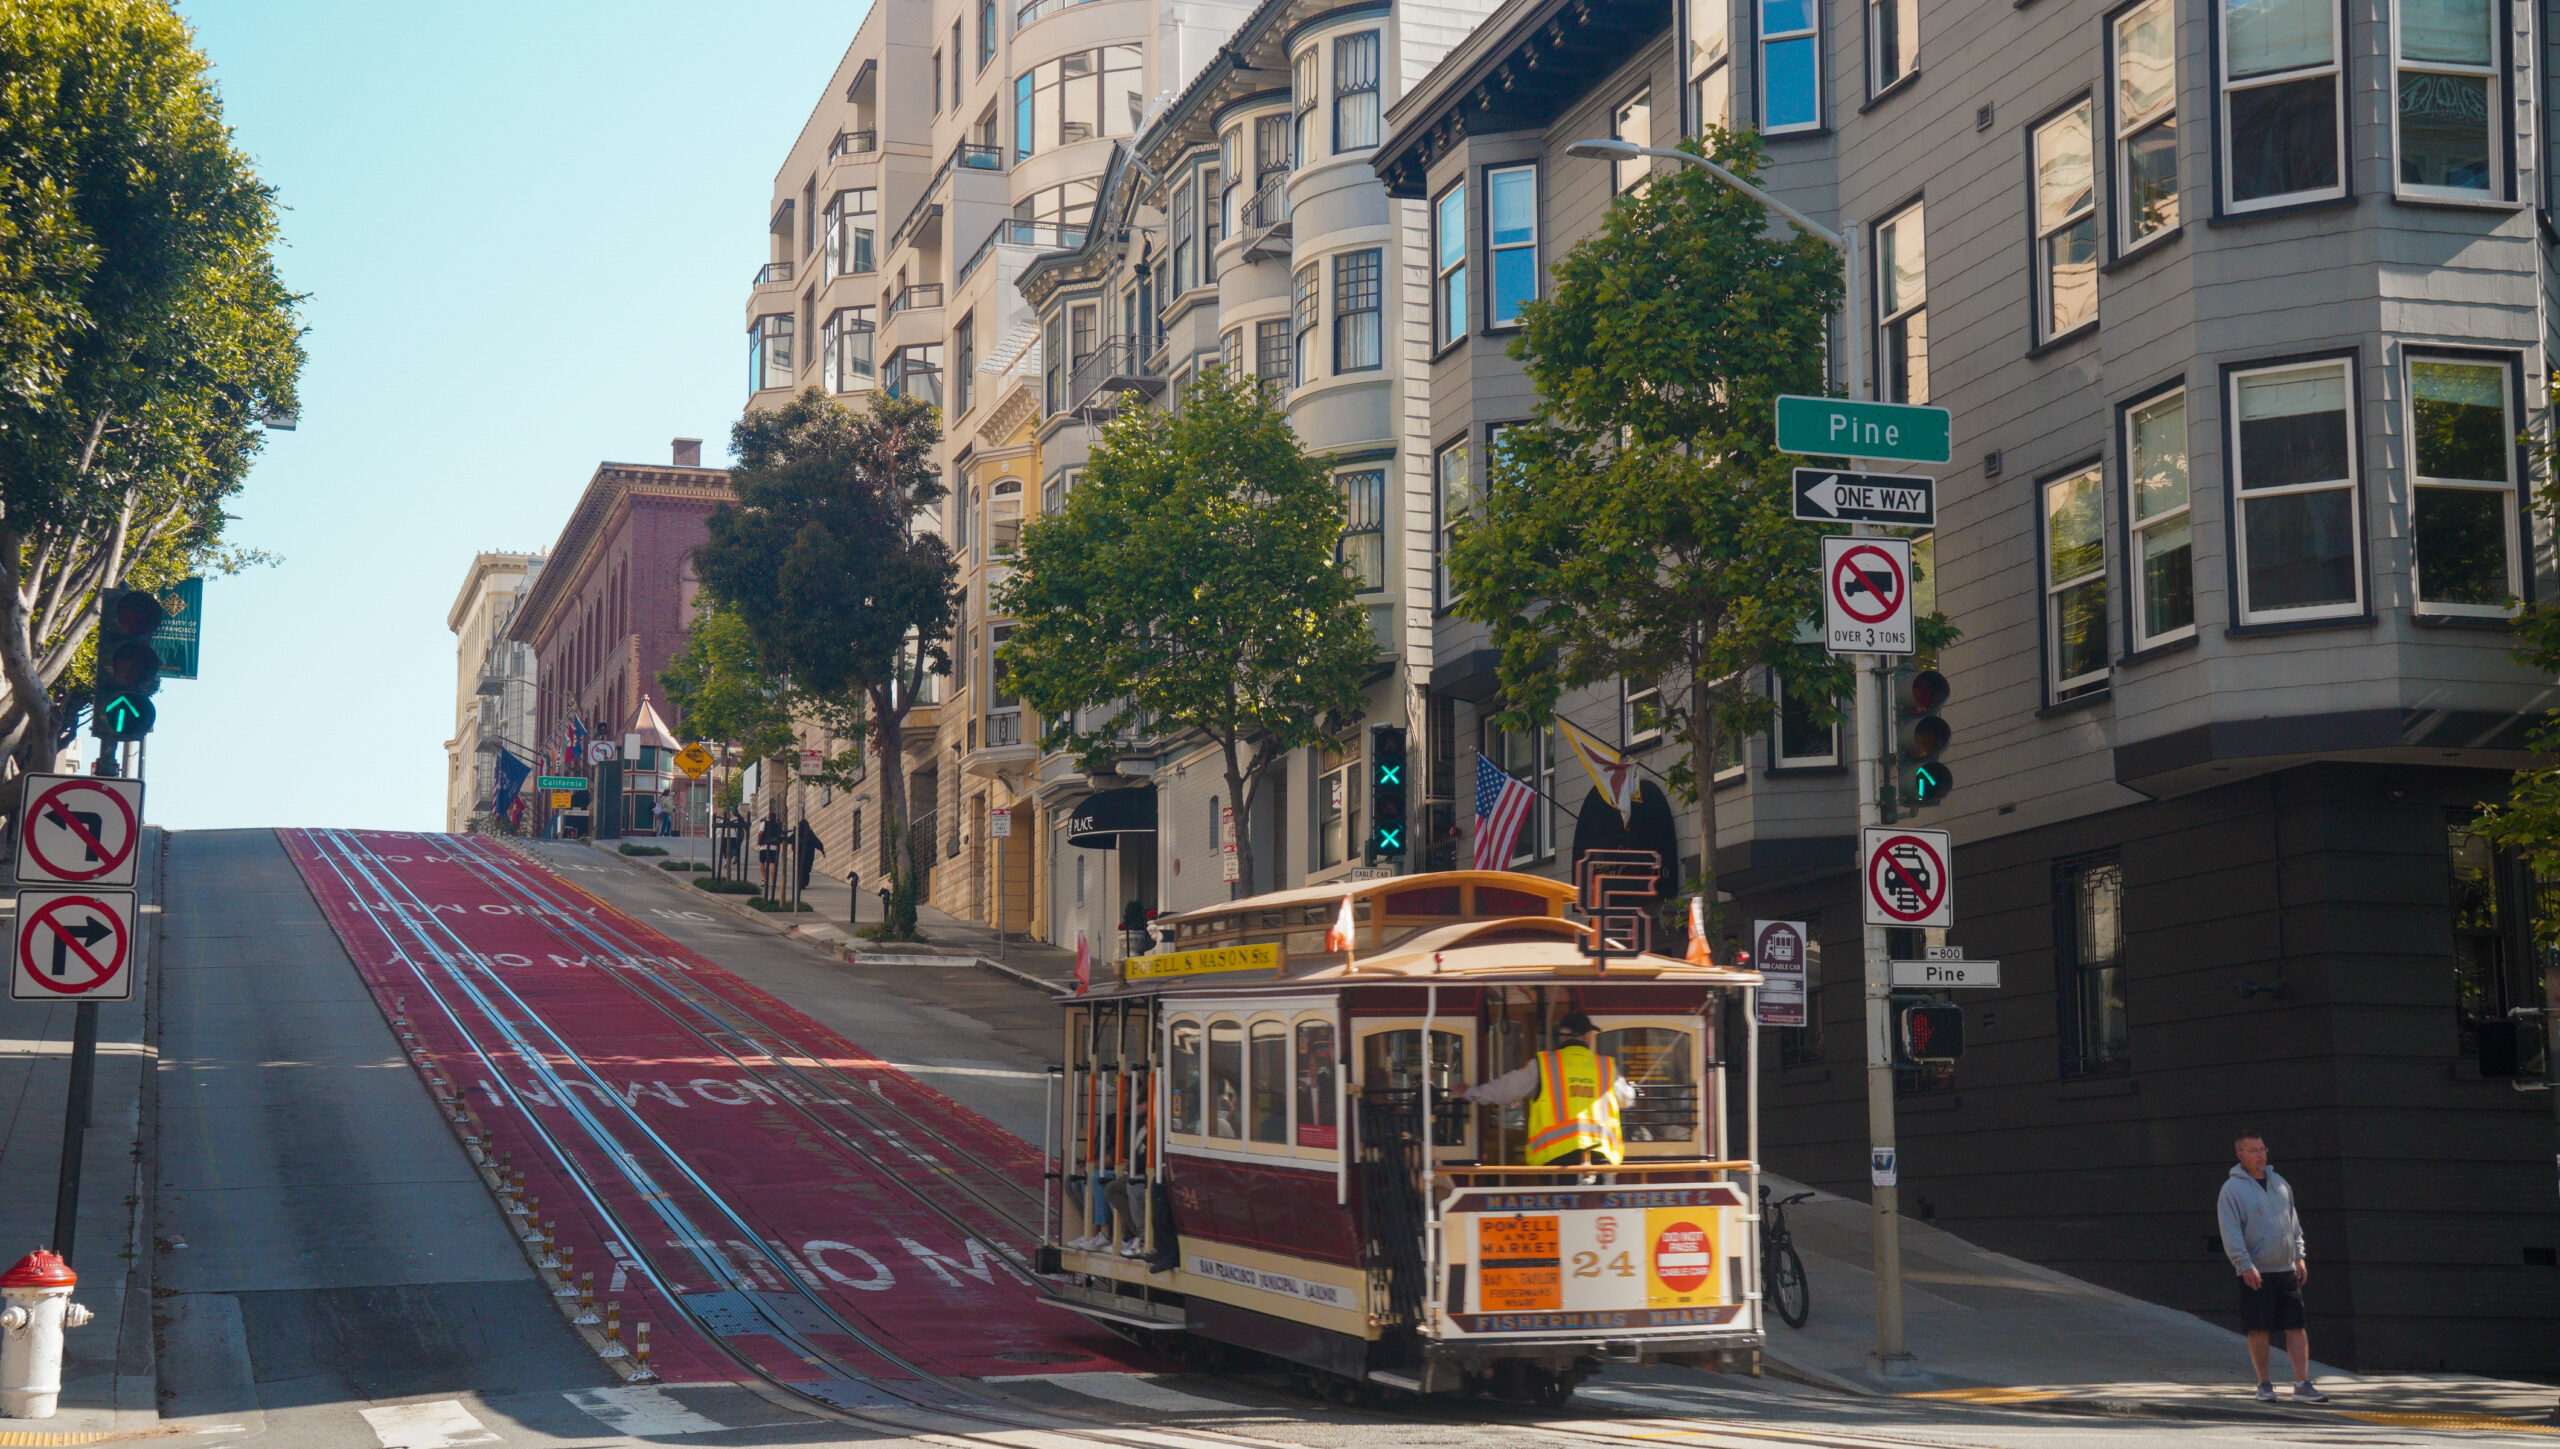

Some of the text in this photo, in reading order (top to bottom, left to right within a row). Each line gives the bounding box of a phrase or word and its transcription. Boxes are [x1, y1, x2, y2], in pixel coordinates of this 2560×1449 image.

[1829, 413, 1899, 446] Pine
[1834, 486, 1921, 511] ONE WAY
[162, 625, 196, 633] FRANCISCO
[1834, 628, 1906, 647] OVER 3 TONS
[542, 779, 582, 787] California
[1074, 816, 1093, 832] PLACE
[651, 908, 716, 922] NO
[1940, 948, 1960, 959] 800
[1131, 957, 1178, 975] POWELL
[1184, 955, 1193, 971] &
[1199, 950, 1248, 968] MASON
[1789, 963, 1800, 971] CAR
[1926, 966, 1965, 981] Pine
[1485, 1193, 1582, 1210] MARKET
[1603, 1191, 1691, 1208] STREET
[1483, 1221, 1557, 1232] POWELL
[1595, 1216, 1618, 1249] SF
[1503, 1233, 1538, 1241] AND
[1661, 1231, 1704, 1242] DO NOT
[1481, 1242, 1558, 1253] MARKET
[1668, 1242, 1700, 1252] PASS
[1572, 1251, 1636, 1278] 24
[1200, 1259, 1214, 1275] SAN
[1215, 1262, 1256, 1285] FRANCISCO
[1658, 1267, 1710, 1277] CABLE CAR
[1489, 1288, 1553, 1298] FISHERMANS
[1475, 1308, 1722, 1331] FISHERMANS WHARF
